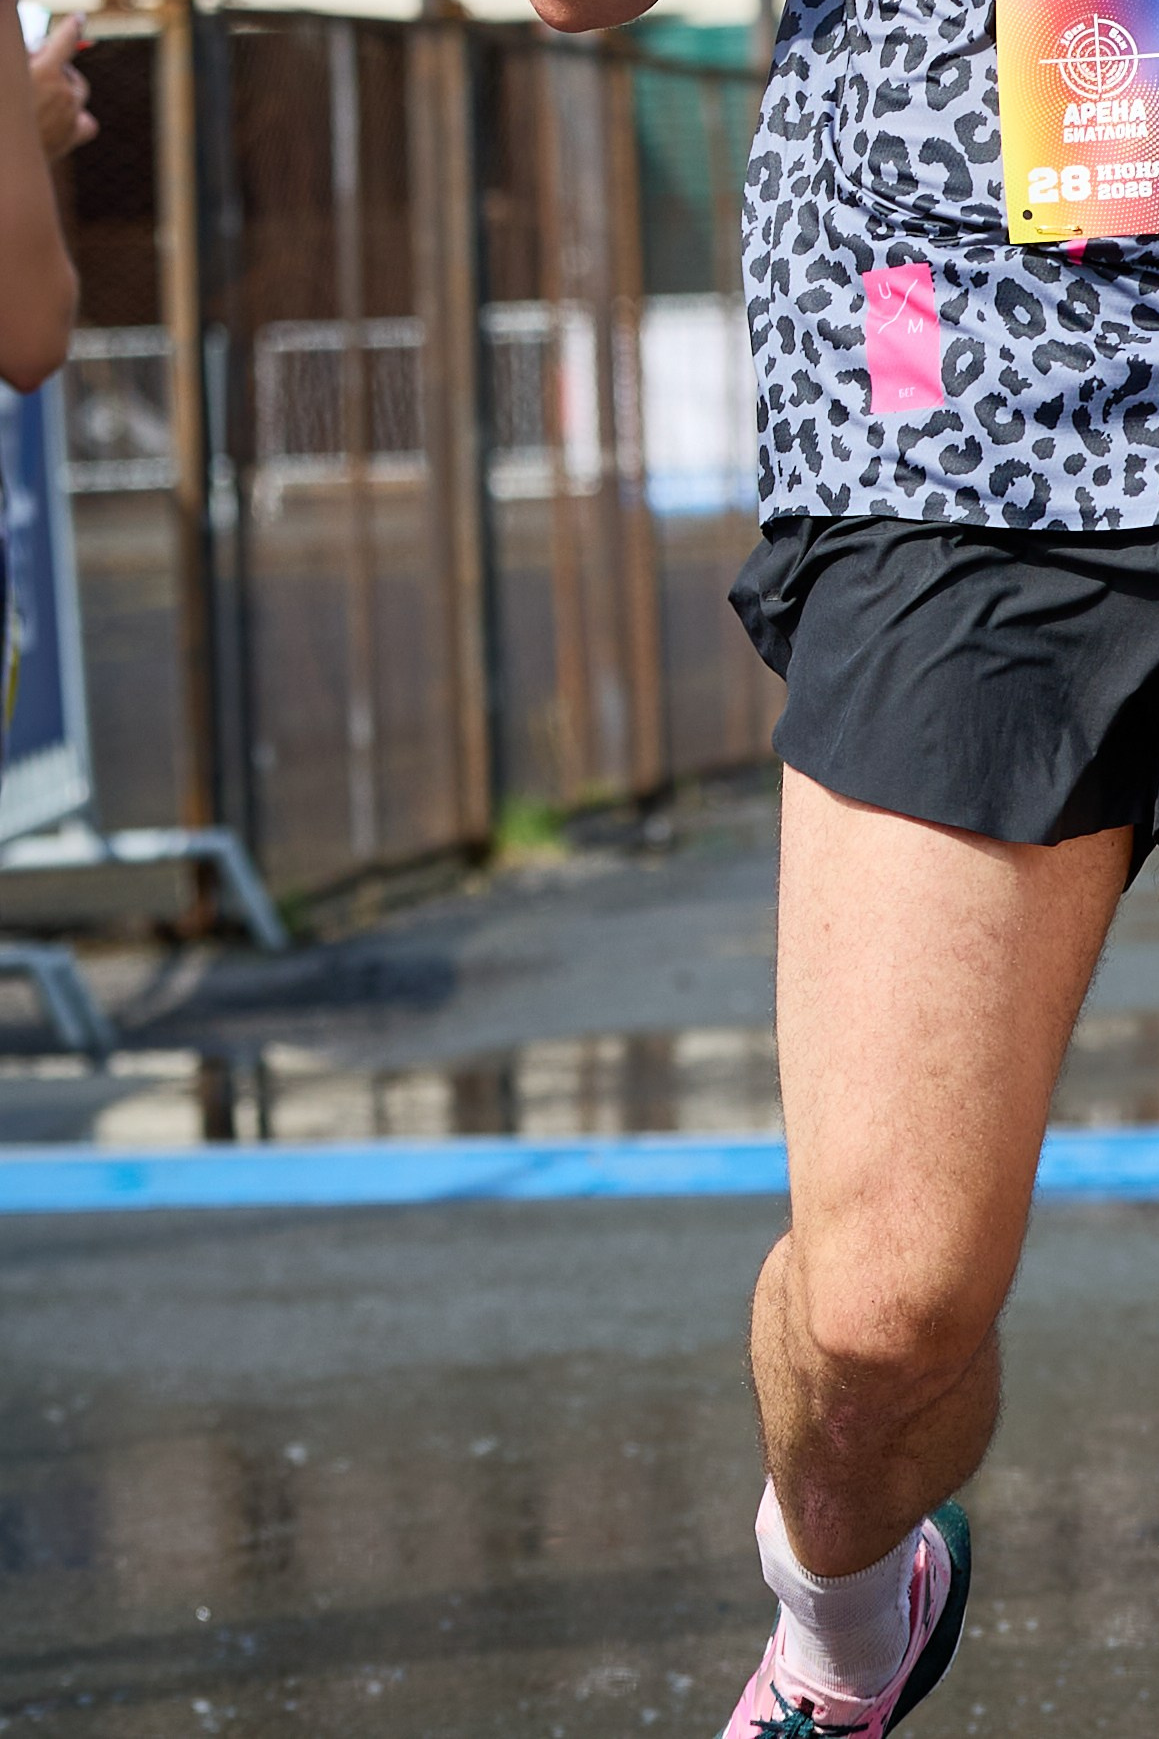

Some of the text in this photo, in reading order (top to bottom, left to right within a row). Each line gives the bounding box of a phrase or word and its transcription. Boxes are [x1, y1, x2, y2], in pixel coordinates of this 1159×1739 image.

[1063, 99, 1147, 126] АРЕНА
[1063, 121, 1149, 144] БИАТЛОНА
[1027, 165, 1092, 204] 28
[1097, 180, 1153, 201] 2026
[898, 386, 916, 399] БЕГ
